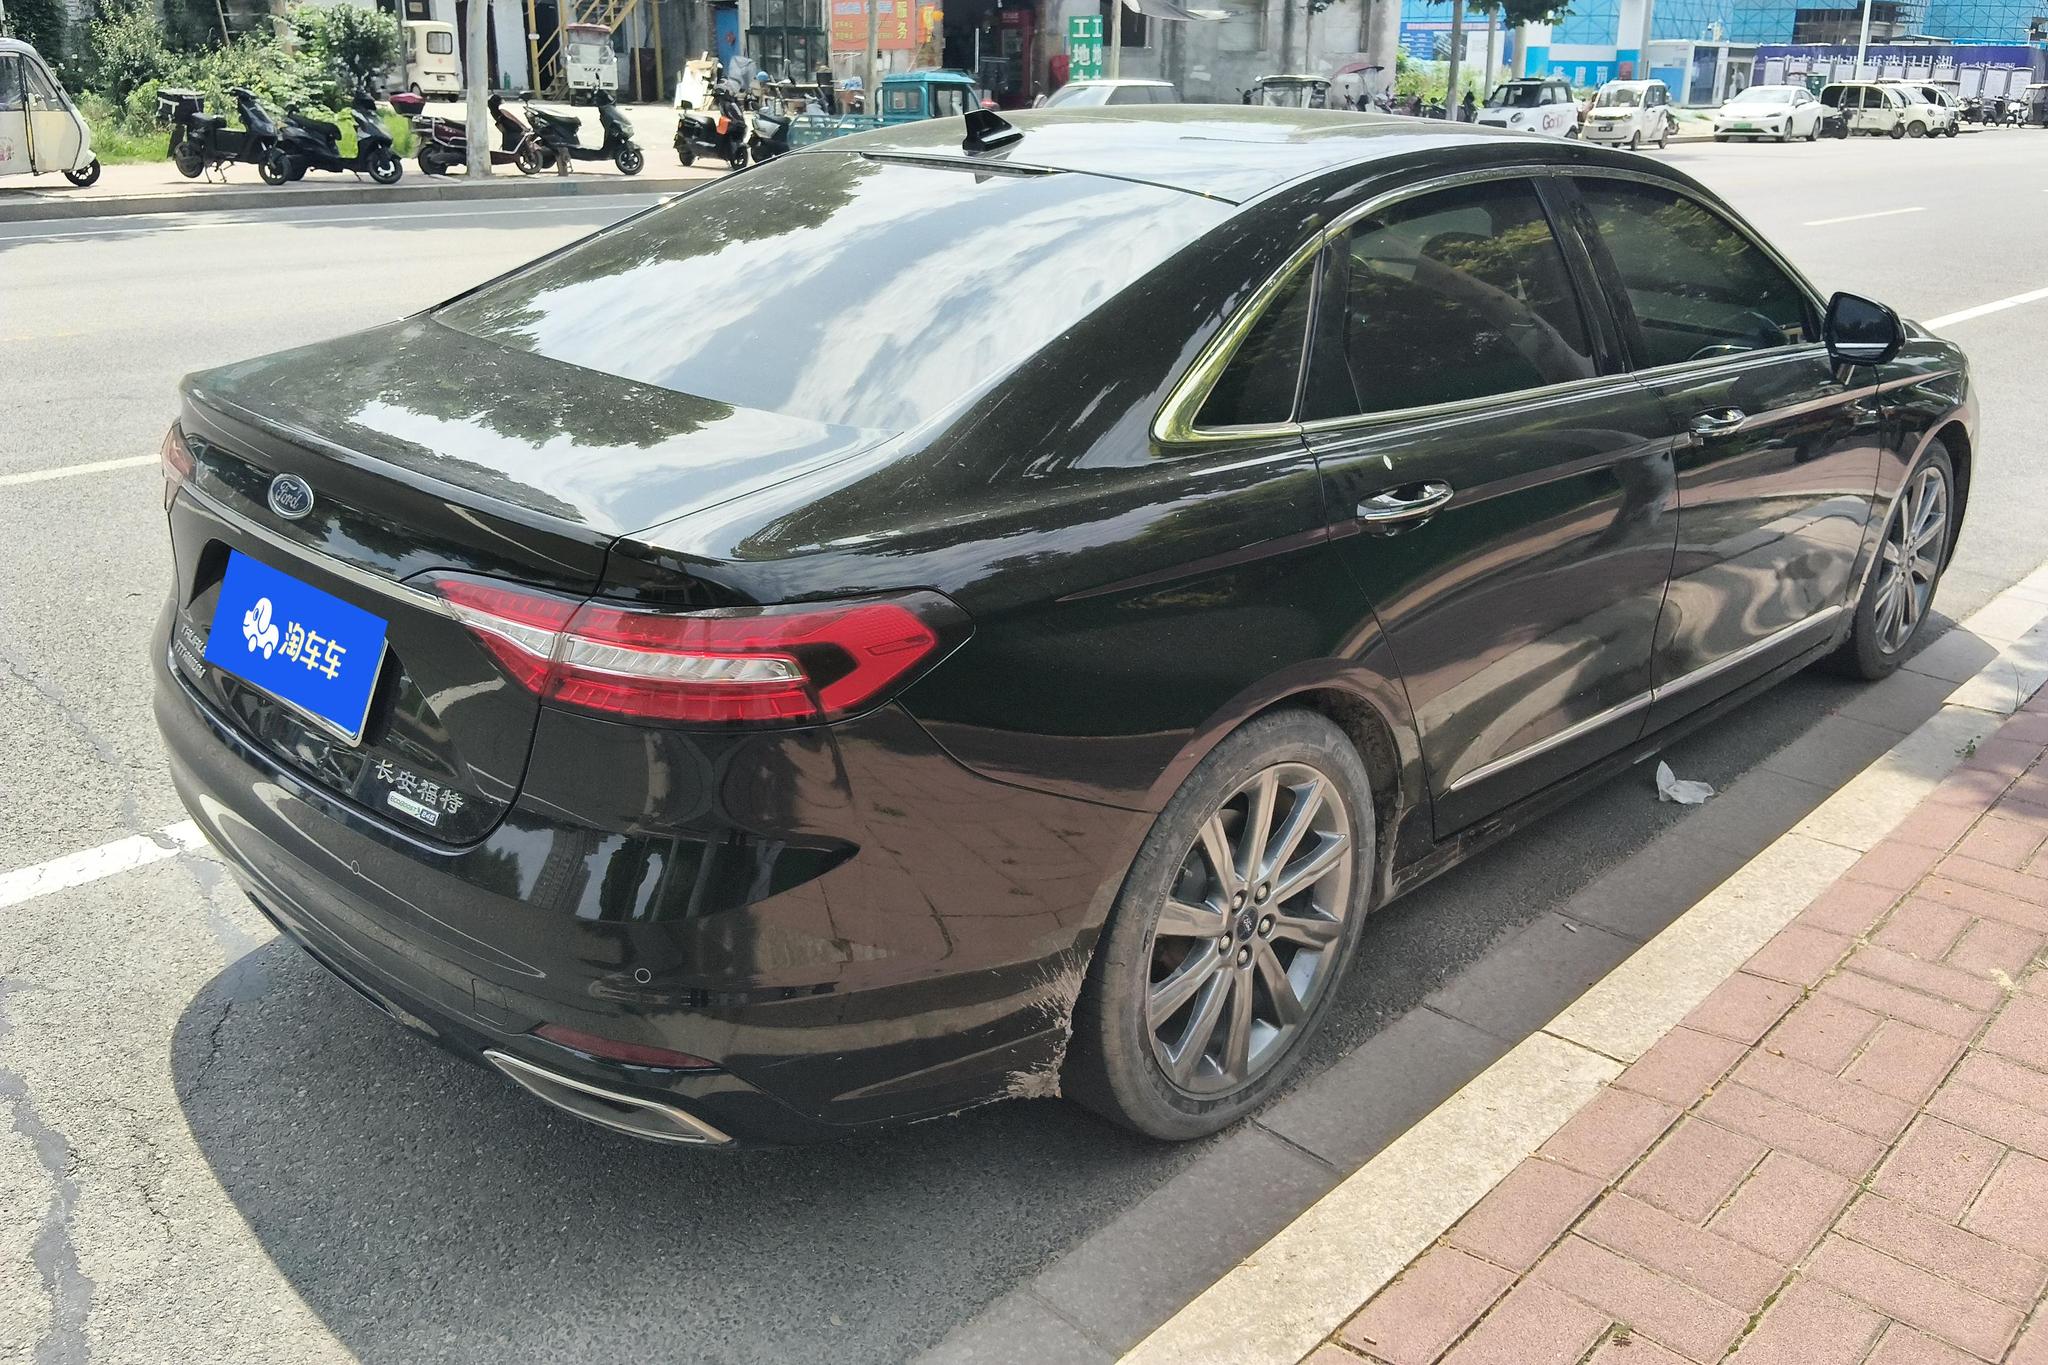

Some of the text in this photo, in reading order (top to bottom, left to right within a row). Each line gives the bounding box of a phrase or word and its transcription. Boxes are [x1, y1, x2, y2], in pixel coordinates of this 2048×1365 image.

[275, 481, 301, 509] Ford
[375, 759, 464, 814] 长安福特
